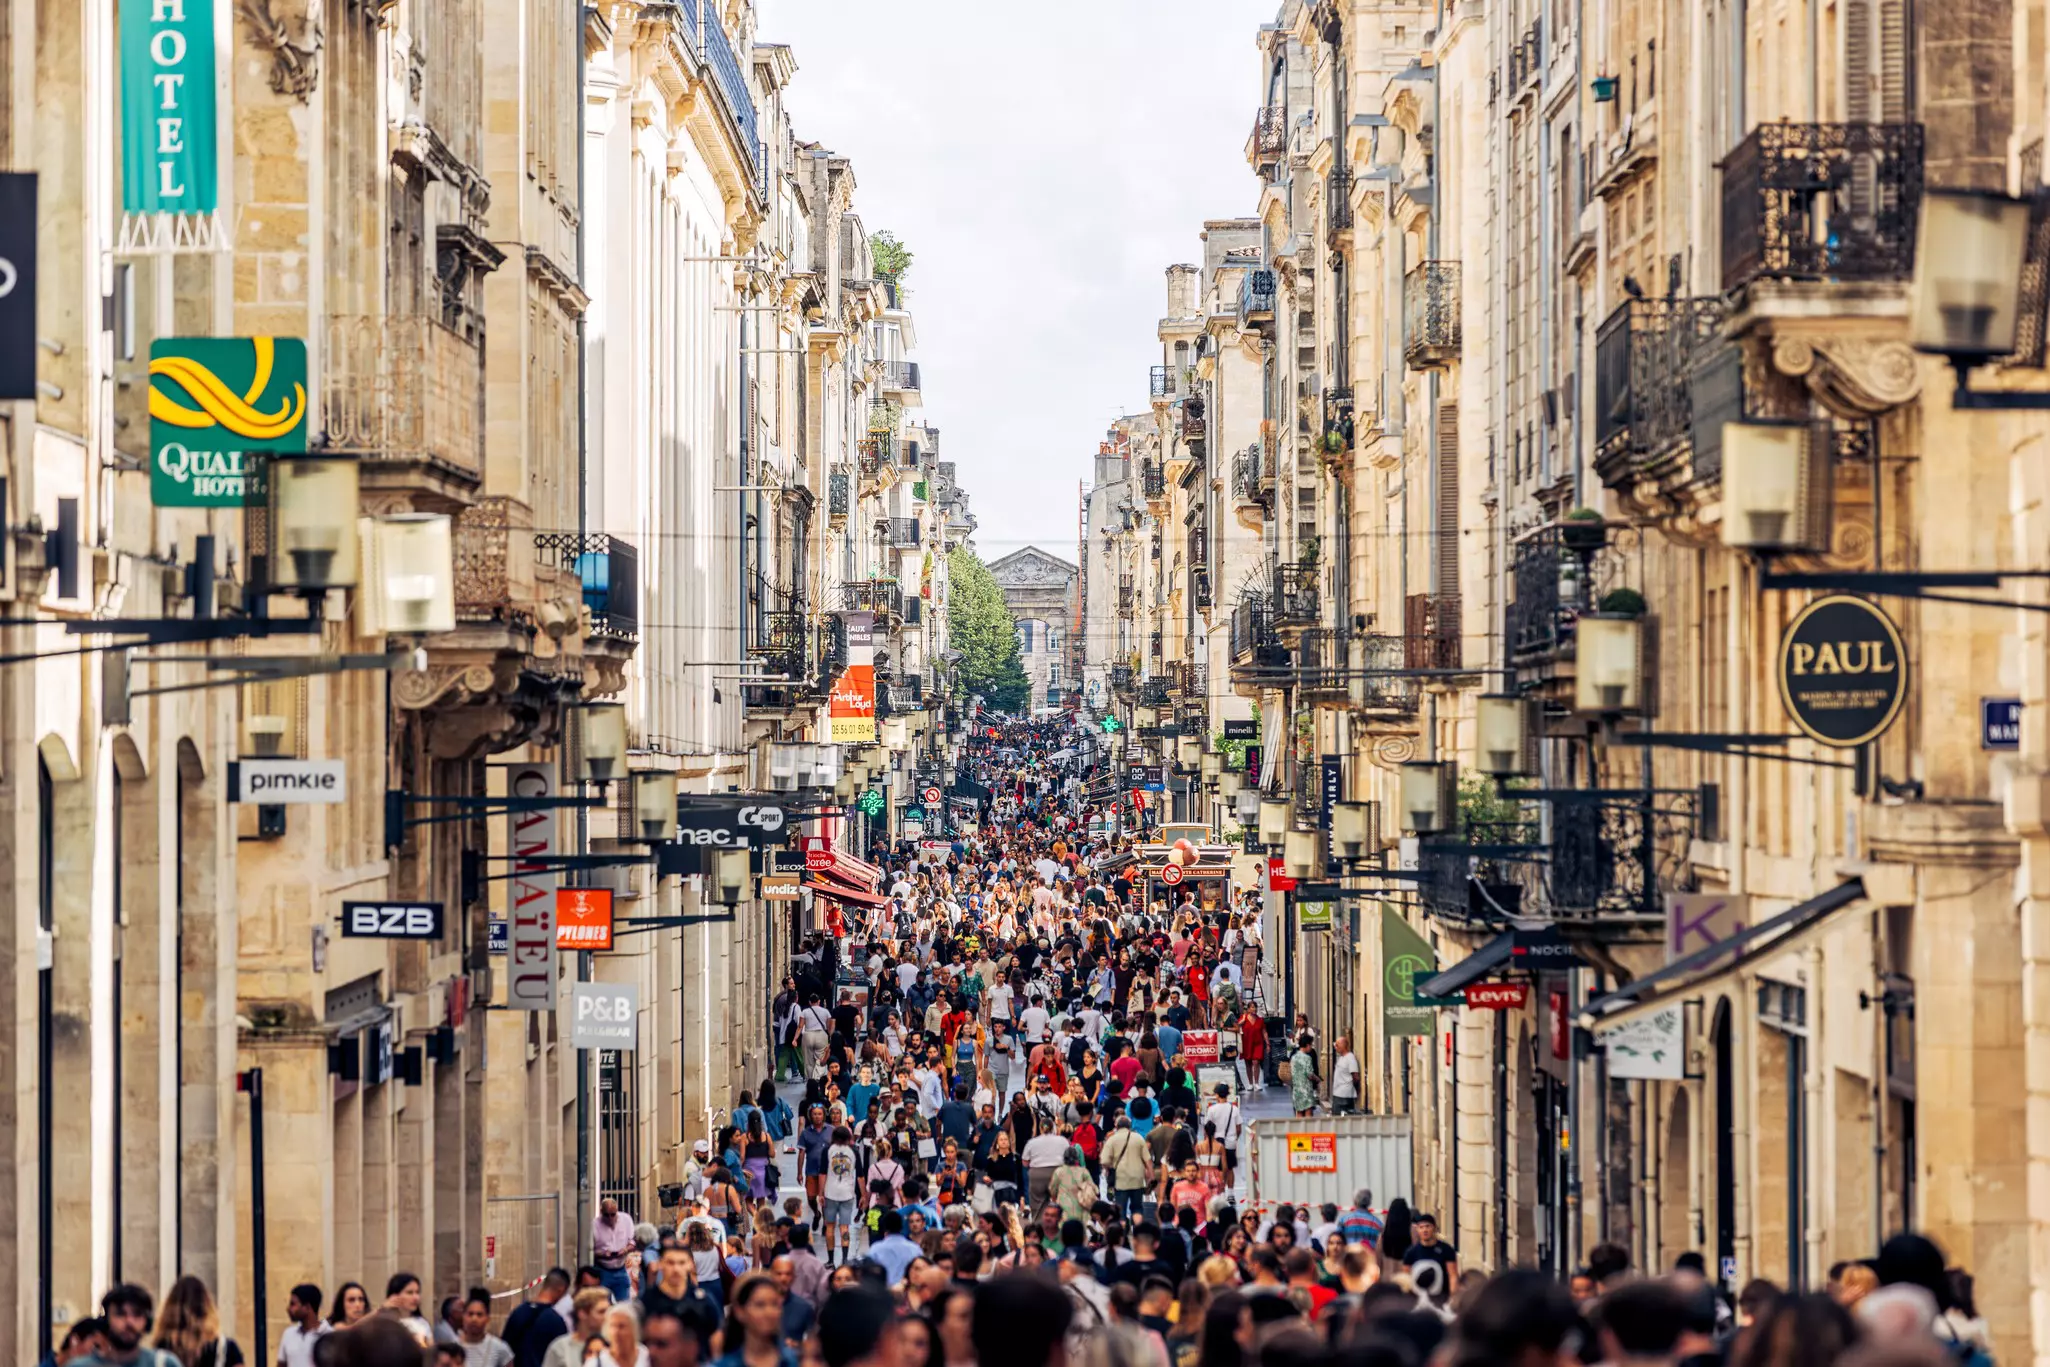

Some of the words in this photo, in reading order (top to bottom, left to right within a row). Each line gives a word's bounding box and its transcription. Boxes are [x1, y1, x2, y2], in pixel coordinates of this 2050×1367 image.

[150, 0, 188, 198] HOTEL
[158, 442, 258, 483] QUAL
[1791, 641, 1896, 675] PAUL
[1228, 726, 1253, 734] minelli
[250, 773, 336, 795] pimkie
[861, 799, 885, 808] 17:22
[761, 813, 780, 823] SPORT
[665, 824, 731, 845] nac
[1270, 866, 1287, 877] HE
[764, 883, 798, 895] undiz
[351, 906, 435, 934] BZB
[578, 995, 632, 1022] P&B
[1187, 1046, 1216, 1055] PROMO
